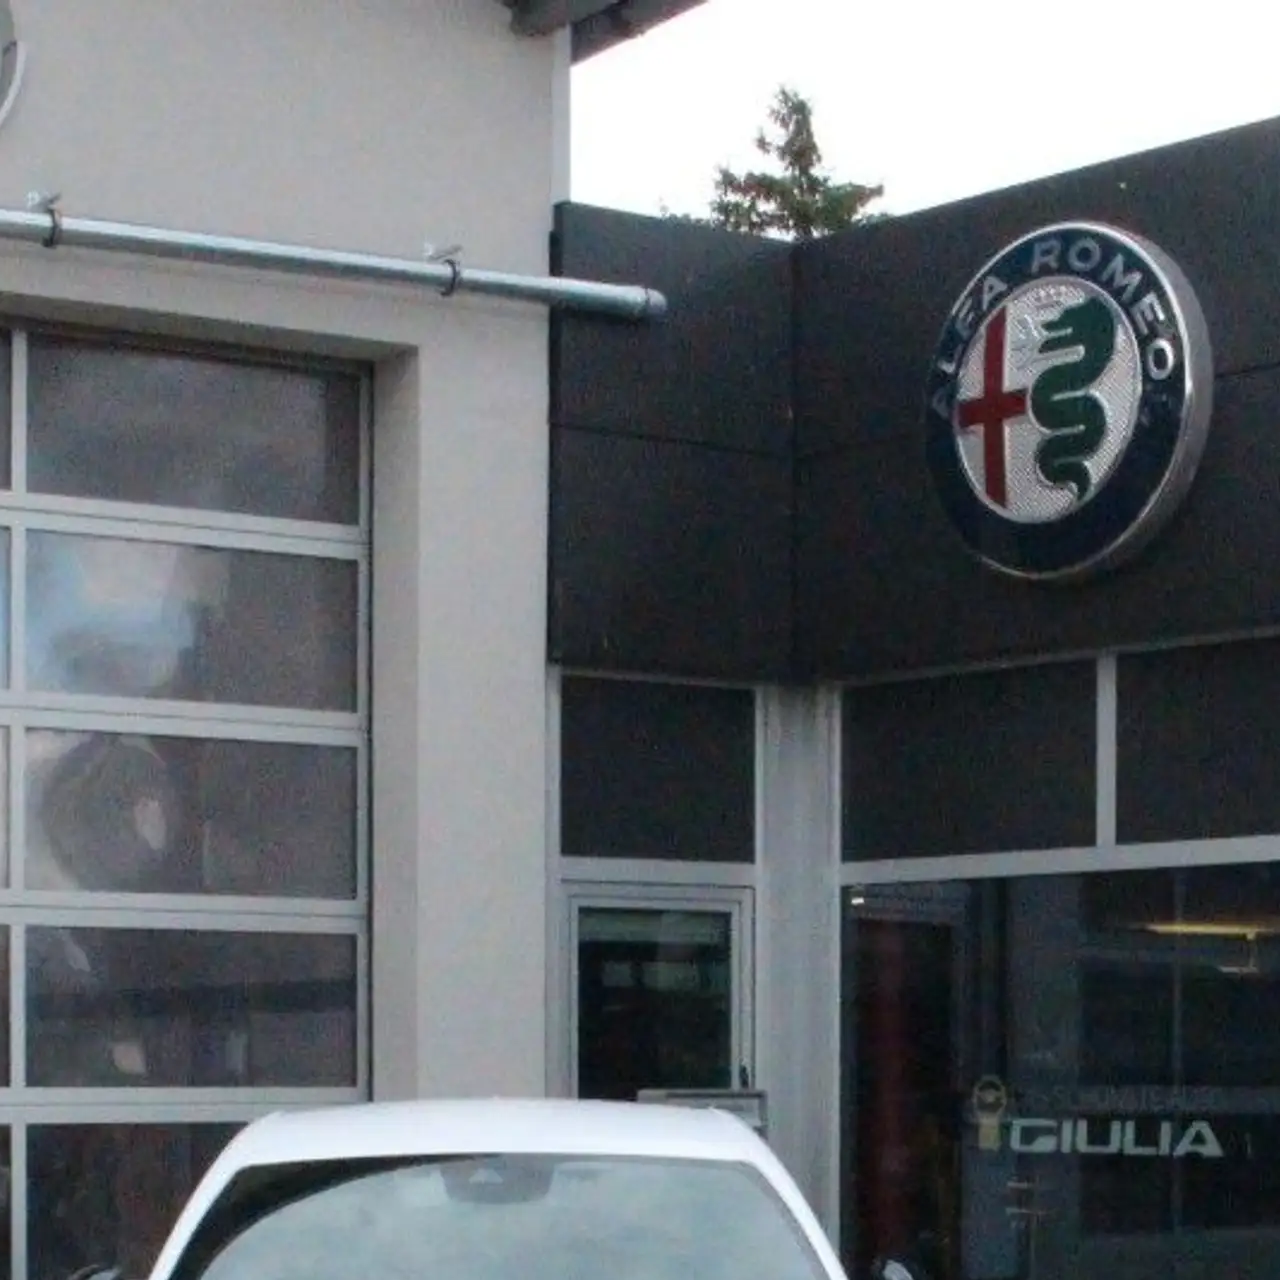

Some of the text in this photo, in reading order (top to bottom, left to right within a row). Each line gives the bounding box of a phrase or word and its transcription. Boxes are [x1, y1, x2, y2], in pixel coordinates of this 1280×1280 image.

[933, 238, 1174, 419] ALFA ROMEO
[1009, 1118, 1224, 1157] GIULIA
